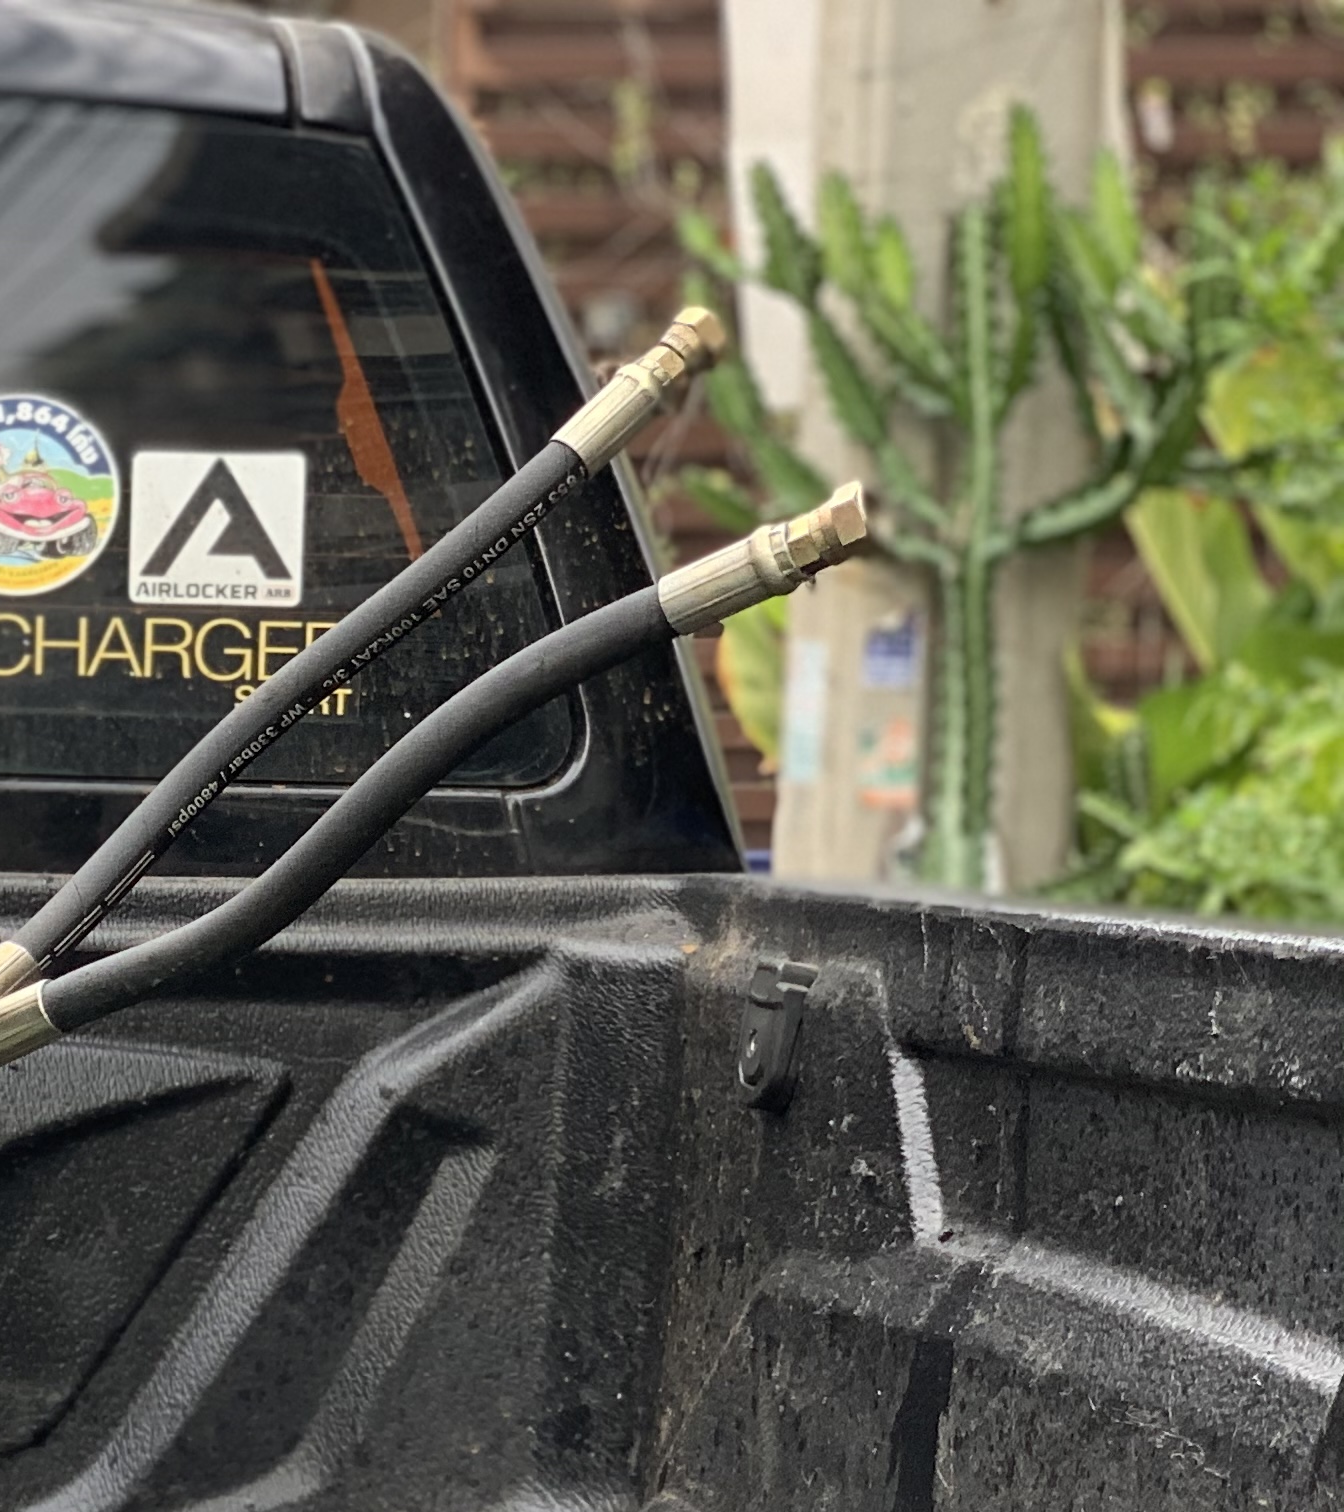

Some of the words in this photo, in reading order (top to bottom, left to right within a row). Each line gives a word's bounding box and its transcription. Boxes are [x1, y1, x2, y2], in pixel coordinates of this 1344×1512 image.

[511, 502, 547, 538] 2SN
[462, 536, 509, 579] DN10
[134, 582, 259, 601] AIRLOCKER
[265, 588, 292, 599] ARB
[422, 577, 462, 612] SAE
[280, 702, 306, 728] WP
[227, 725, 278, 774] 330bar
[167, 780, 219, 838] 4800psi
